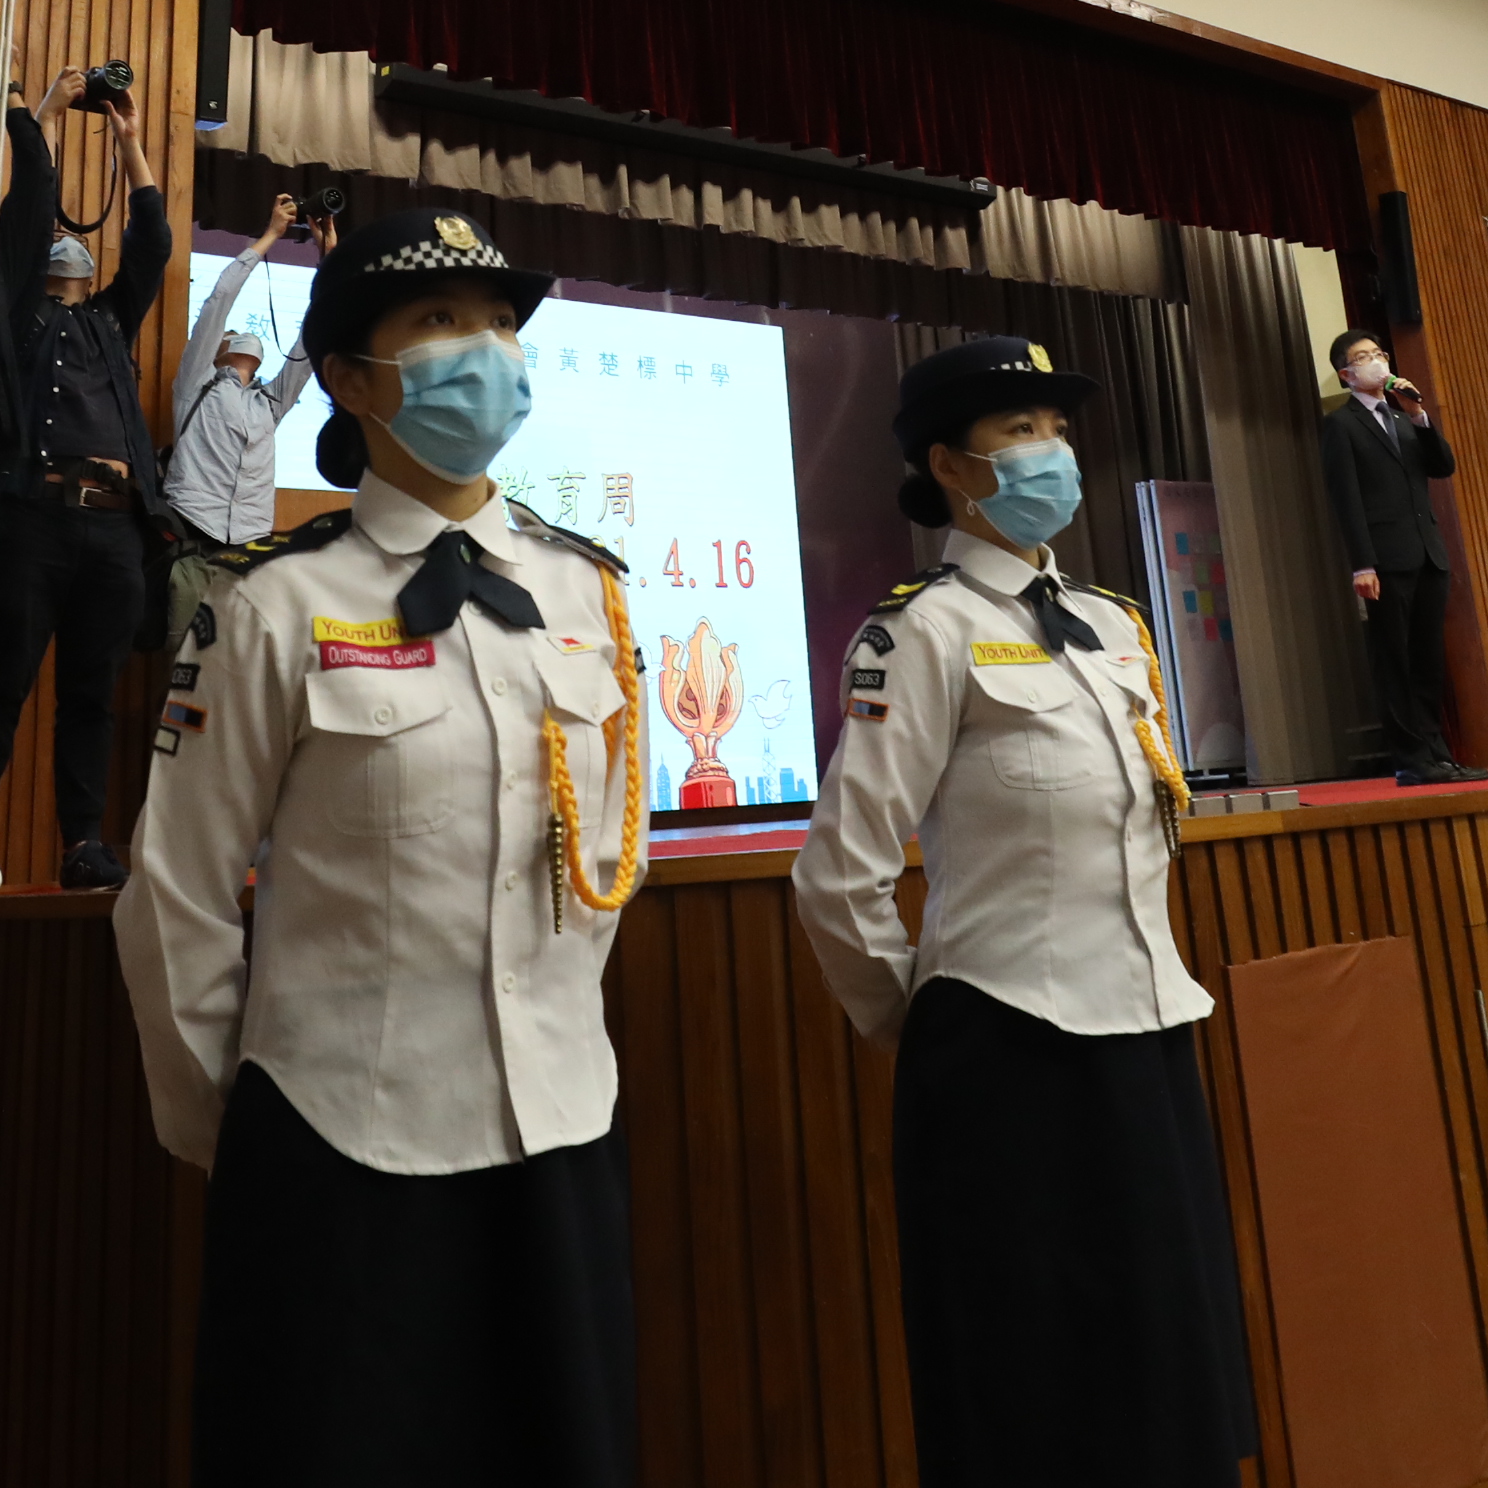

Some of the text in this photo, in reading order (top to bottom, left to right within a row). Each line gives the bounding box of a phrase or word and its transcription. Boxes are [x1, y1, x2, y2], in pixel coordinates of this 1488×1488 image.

[322, 620, 375, 642] YOUTH
[328, 645, 428, 666] OUTSTANDING GUARD
[977, 645, 1017, 659] YOUTH
[854, 672, 881, 686] S063
